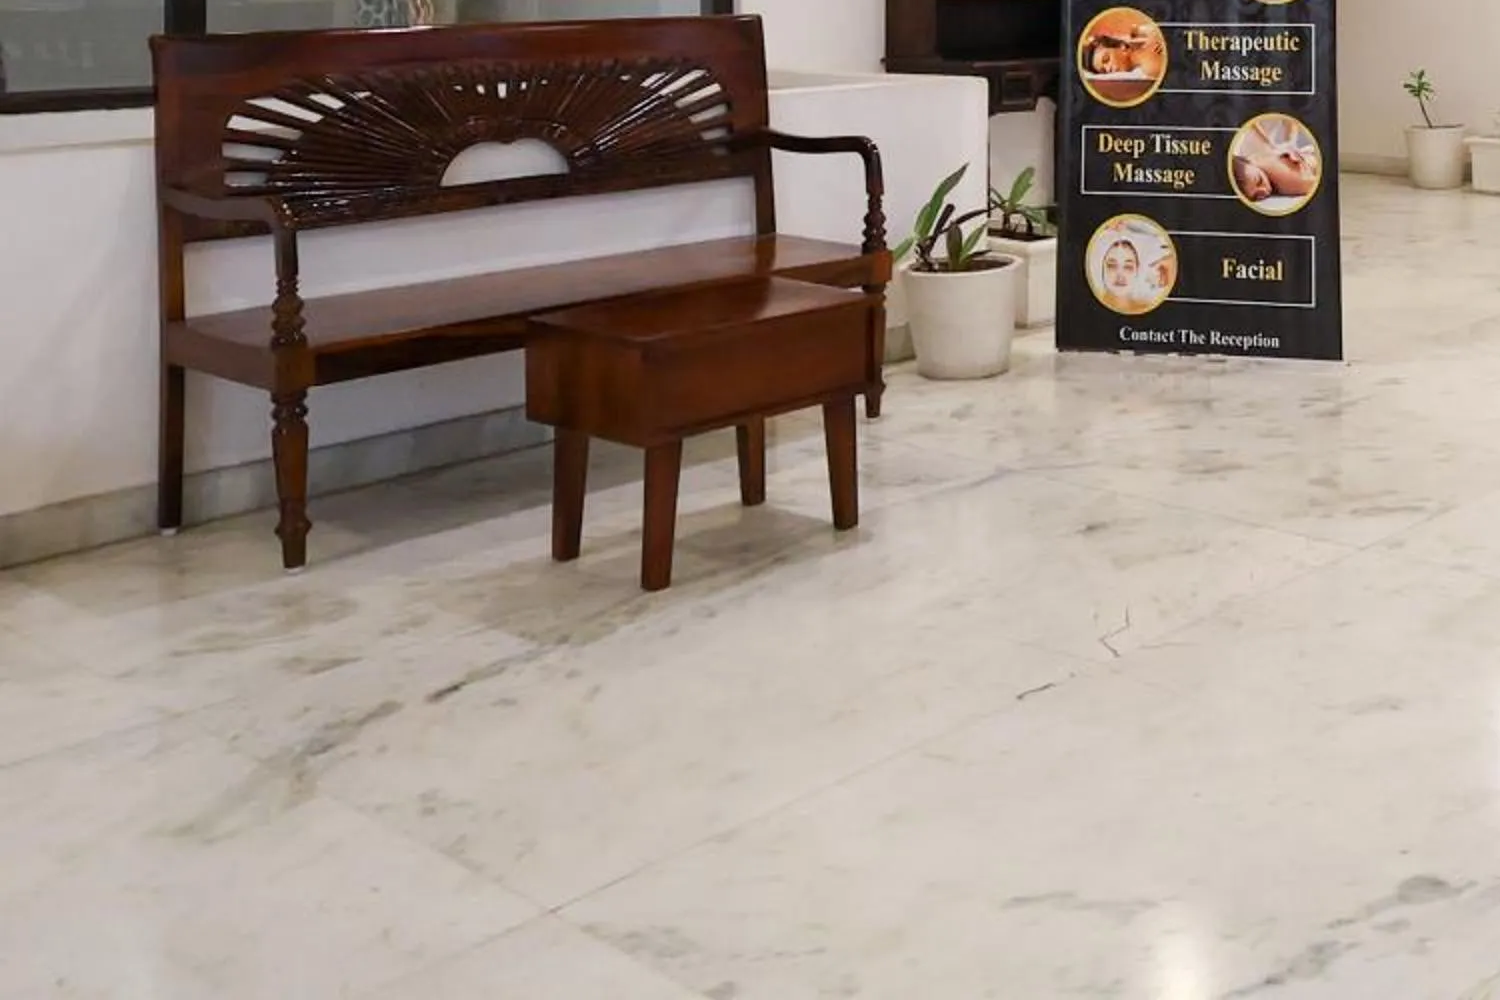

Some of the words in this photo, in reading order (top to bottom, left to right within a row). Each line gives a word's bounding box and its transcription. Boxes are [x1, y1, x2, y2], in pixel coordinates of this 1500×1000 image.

[1184, 30, 1300, 56] Therapeutic
[1200, 60, 1282, 86] Massage
[1098, 132, 1145, 158] Deep
[1150, 133, 1212, 156] Tissue
[1113, 162, 1195, 188] Massage
[1222, 258, 1283, 281] Facial
[1119, 326, 1174, 343] Contact
[1178, 328, 1207, 344] The
[1210, 331, 1280, 350] Reception
